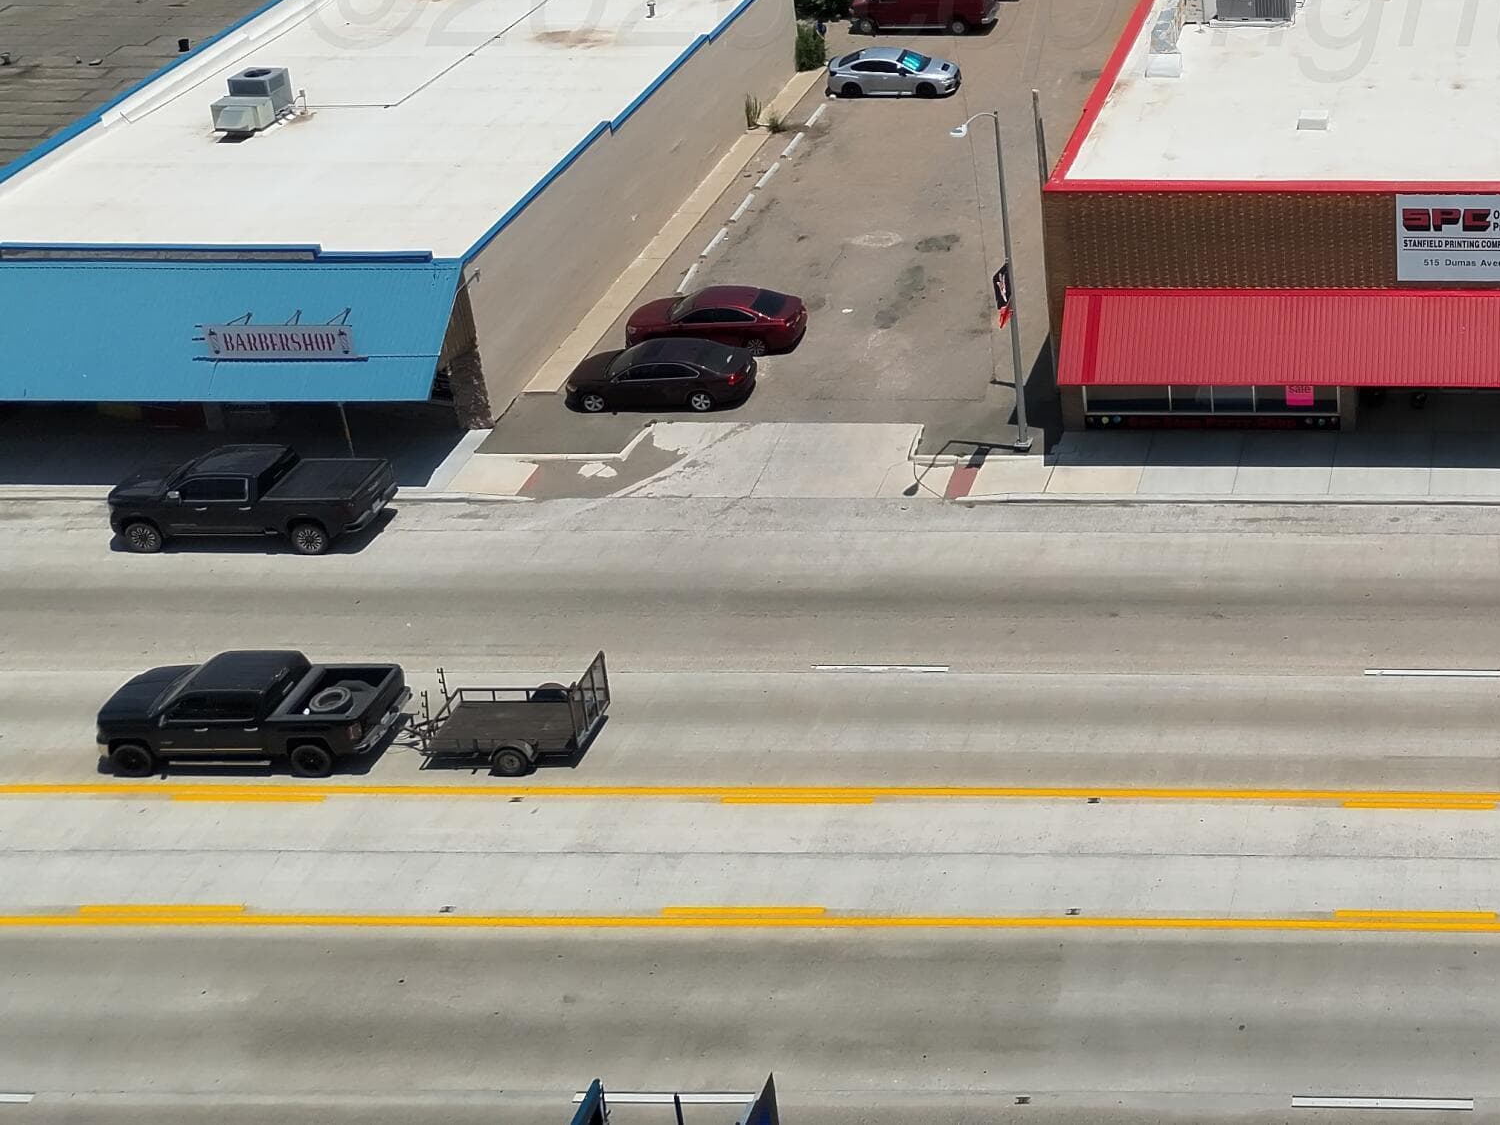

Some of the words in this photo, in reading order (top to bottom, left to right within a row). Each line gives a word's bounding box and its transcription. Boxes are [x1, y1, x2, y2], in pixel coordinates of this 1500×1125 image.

[1402, 208, 1491, 232] SPC
[1403, 239, 1443, 249] STANFIELD
[1445, 239, 1480, 249] PRINTING
[1423, 259, 1440, 267] 515
[1444, 259, 1477, 267] Dumas
[223, 332, 337, 352] BARBERSHOP
